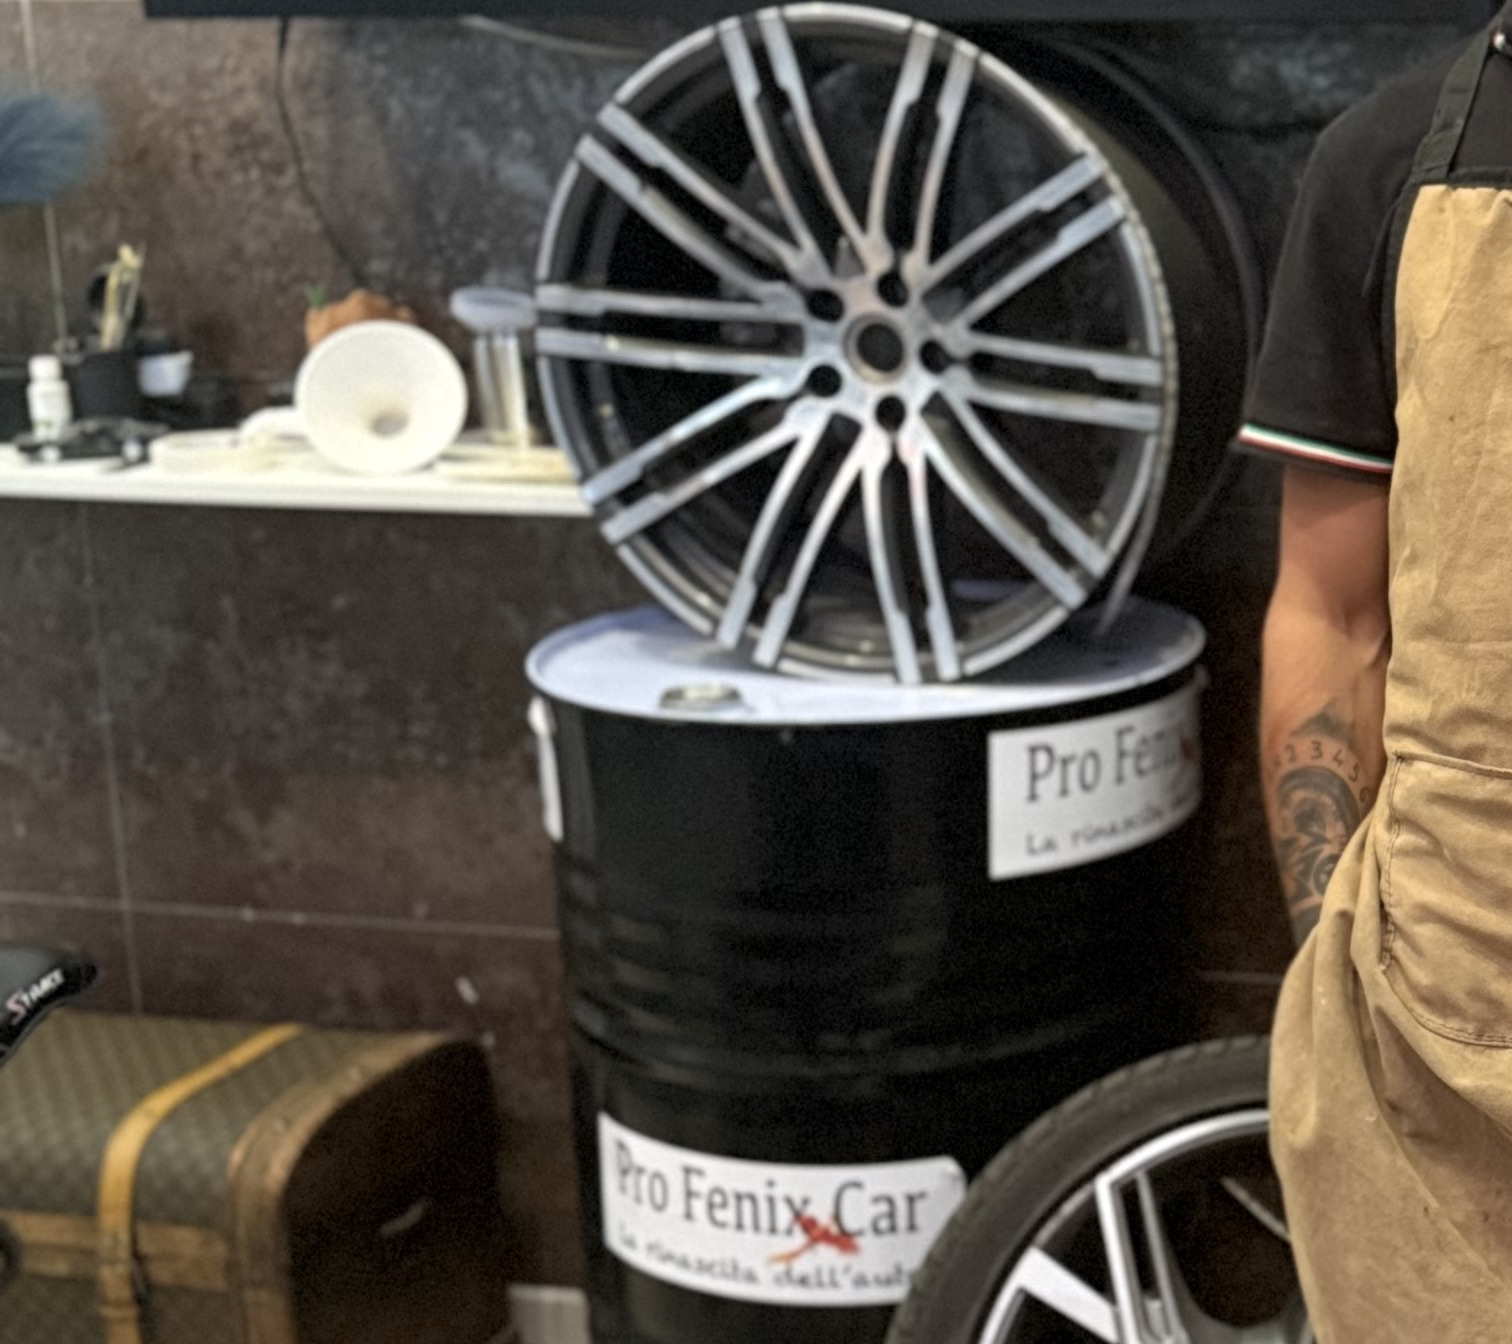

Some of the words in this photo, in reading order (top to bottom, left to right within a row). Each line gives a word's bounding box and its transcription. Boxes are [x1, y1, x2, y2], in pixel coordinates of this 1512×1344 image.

[1026, 742, 1102, 803] Pro
[1310, 740, 1324, 761] 3
[615, 1137, 669, 1214] Pro
[681, 1163, 811, 1237] Fenix
[833, 1178, 928, 1238] Car
